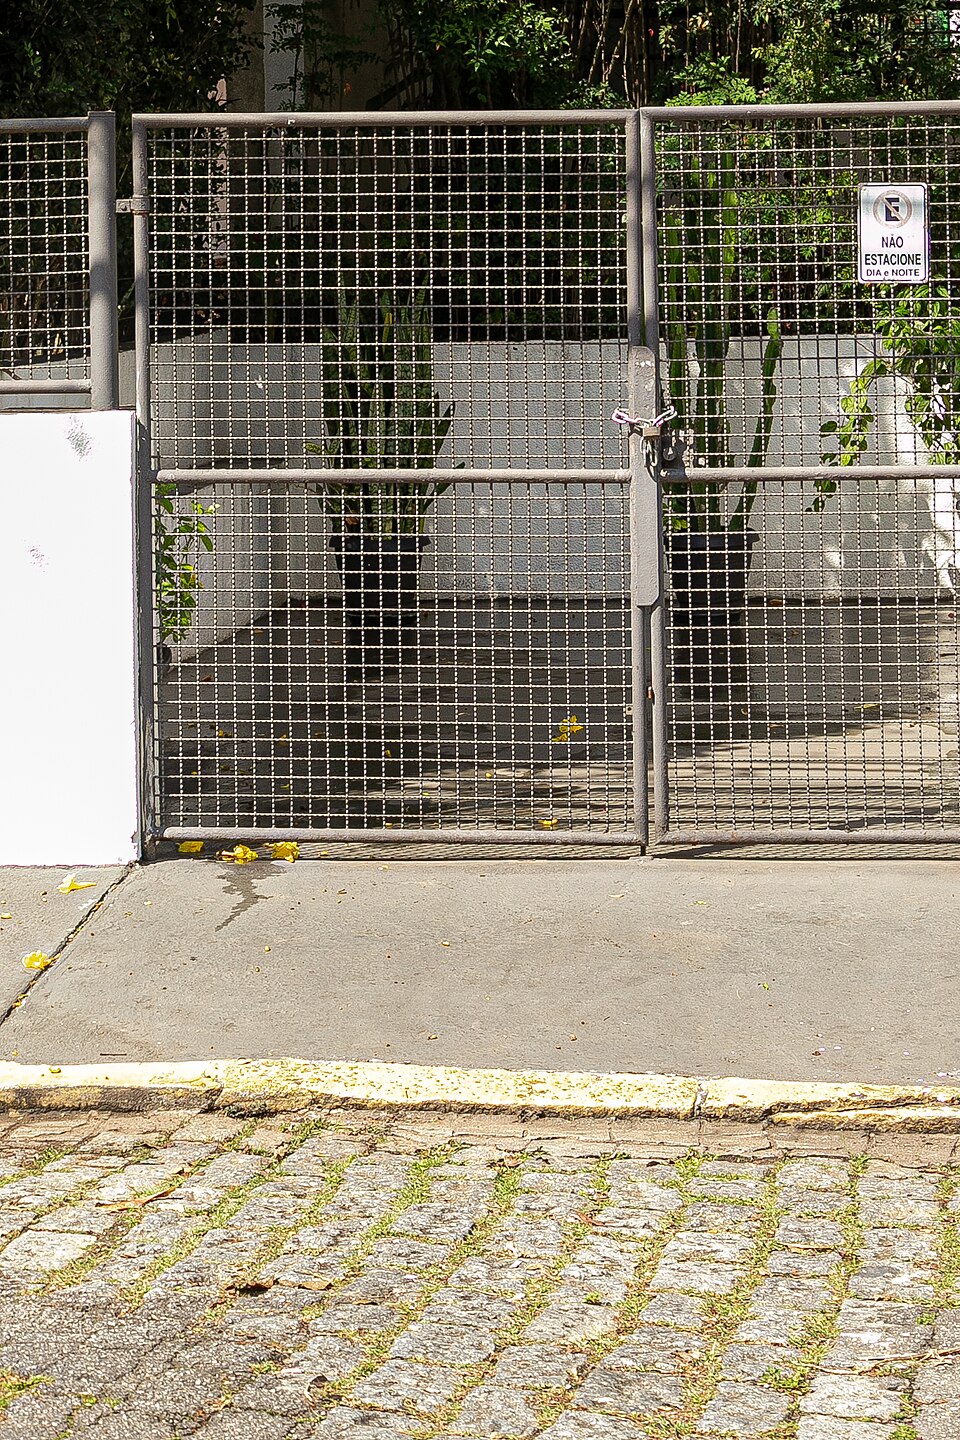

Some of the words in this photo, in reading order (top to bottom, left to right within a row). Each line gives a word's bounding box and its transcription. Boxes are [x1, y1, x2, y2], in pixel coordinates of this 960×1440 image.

[881, 233, 904, 248] NÃO
[864, 254, 922, 266] ESTACIONE
[866, 268, 882, 277] DIA
[891, 268, 920, 277] NOITE
